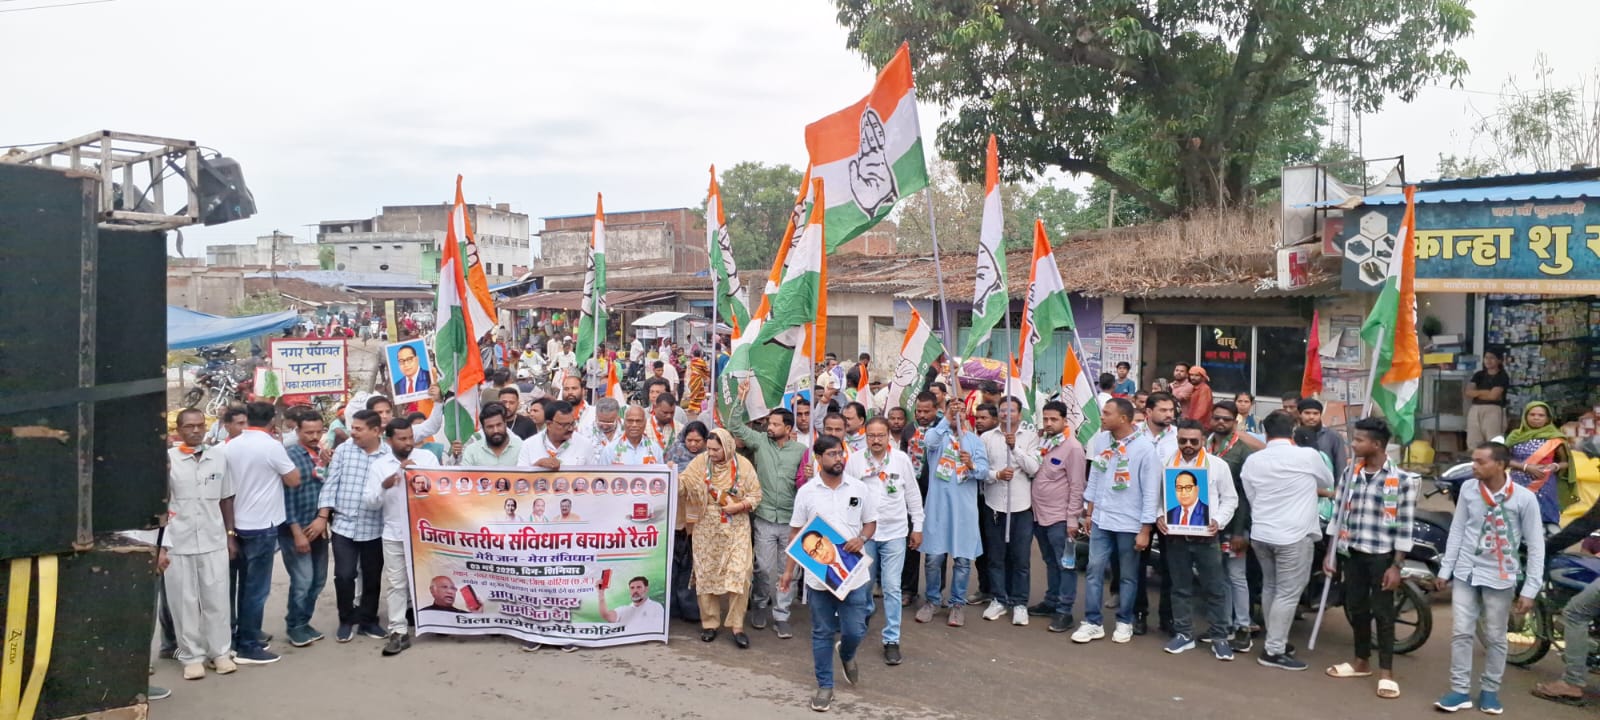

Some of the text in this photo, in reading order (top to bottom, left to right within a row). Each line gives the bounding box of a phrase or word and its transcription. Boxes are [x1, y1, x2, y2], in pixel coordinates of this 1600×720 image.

[1414, 228, 1514, 267] कान्हा
[278, 348, 303, 358] नगर
[288, 363, 327, 375] पटना
[419, 519, 659, 550] जिला स्तरीय संविधान बचाओ रैली
[475, 552, 493, 561] मेरी
[528, 554, 547, 562] मेरा
[551, 552, 594, 562] संविधान
[489, 590, 577, 606] आप सब सादर
[501, 604, 547, 619] आमंत्रित
[456, 615, 626, 635] जिला कांग्रेस कमेटी कोरिया
